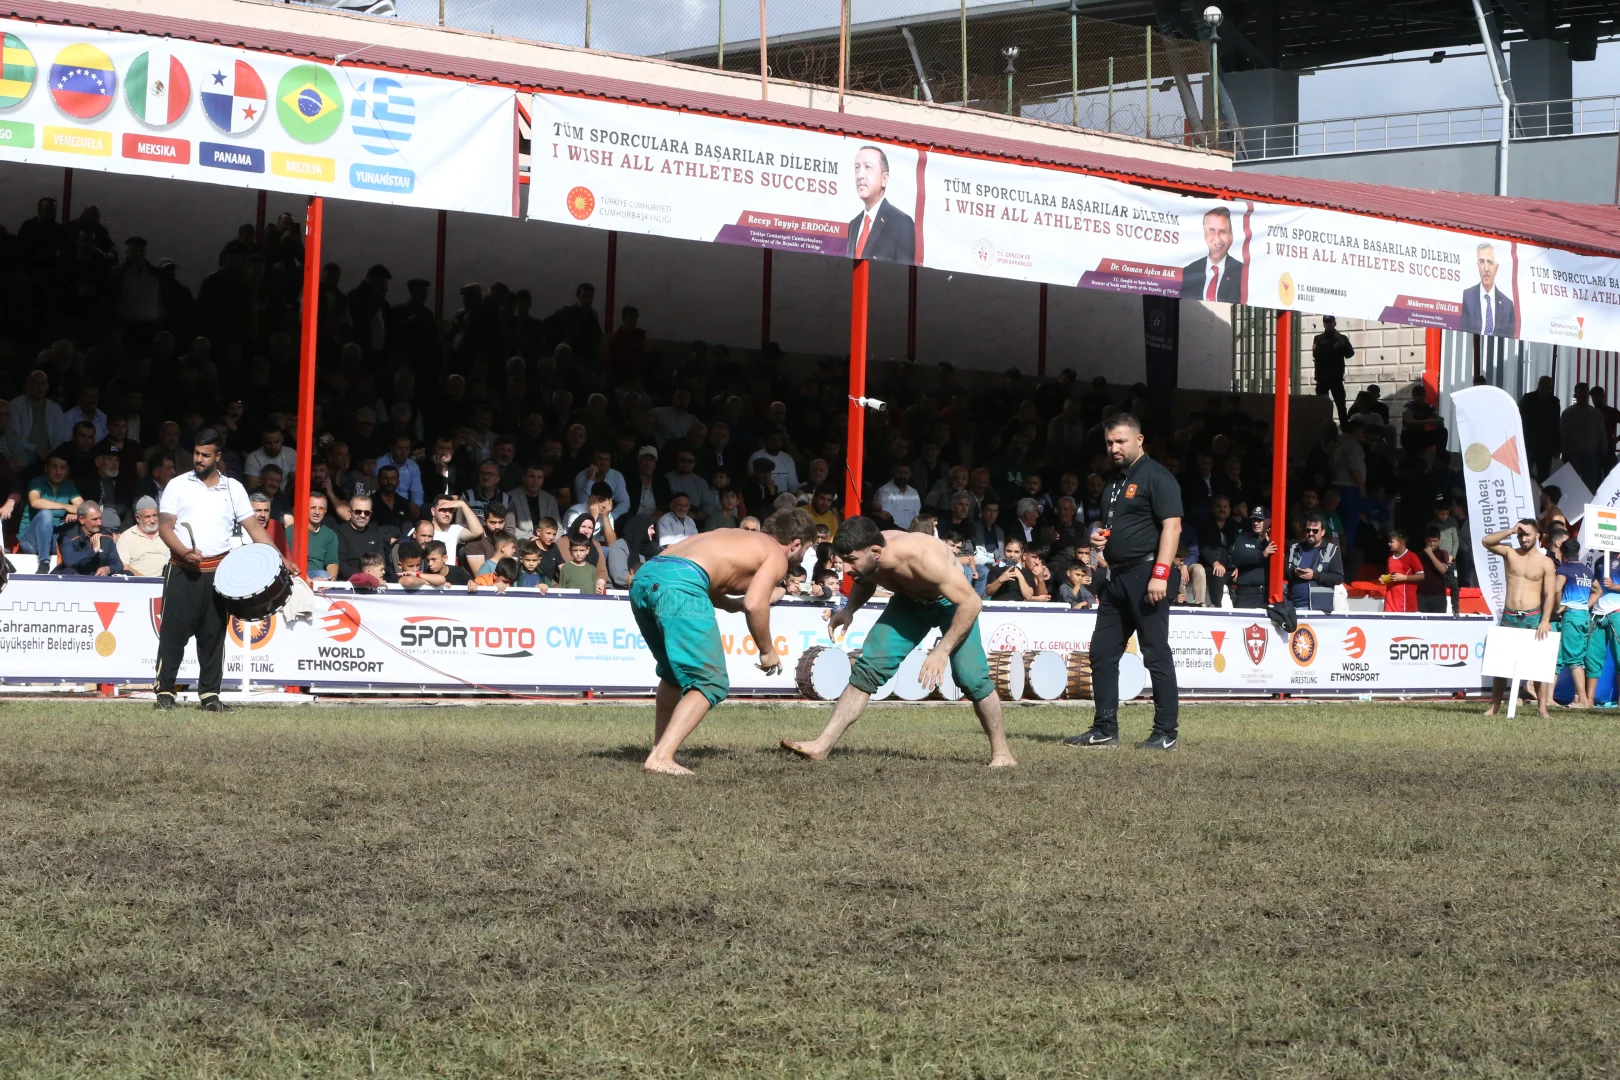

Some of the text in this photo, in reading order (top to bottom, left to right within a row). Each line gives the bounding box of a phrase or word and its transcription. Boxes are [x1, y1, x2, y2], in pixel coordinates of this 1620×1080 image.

[53, 133, 103, 150] VENEZUELA
[553, 122, 838, 175] TÜM SPORCULARA BAŞARILAR DİLERİM
[137, 142, 176, 158] MEKSIKA
[213, 150, 252, 166] PANAMA
[552, 143, 838, 196] I WISH ALL ATHLETES SUCCESS
[356, 169, 410, 189] YUNANİSTAN
[944, 177, 1180, 226] TÜM SPORCULARA BAŞARILAR DİLERİM
[747, 214, 840, 234] Recep Tayyip ERDOĞAN
[945, 198, 1180, 245] I WISH ALL ATHLETES SUCCESS
[1267, 224, 1461, 265] TÜM SPORCULARA BAŞARILAR DİLERİM
[1110, 262, 1120, 271] Dr.
[1121, 264, 1142, 274] Osman
[1162, 269, 1176, 278] BAK
[1266, 242, 1460, 282] I WISH ALL ATHLETES SUCCESS
[1530, 265, 1550, 279] TÜM
[1553, 269, 1606, 288] SPORCULARA
[1532, 282, 1536, 294] I
[1540, 282, 1568, 298] WISH
[1572, 287, 1589, 301] ALL
[0, 637, 94, 653] üyükşehir Belediyesi
[546, 626, 584, 648] CW
[318, 646, 365, 659] WORLD
[1034, 641, 1046, 650] T.C.
[1048, 641, 1077, 652] GENÇLİK
[1171, 647, 1213, 659] amanmaraş
[227, 662, 275, 673] WRTLING
[298, 659, 384, 672] ETHNOSPORT
[1185, 658, 1213, 670] Belediyesi
[1342, 663, 1370, 671] WORLD
[1290, 676, 1318, 684] WRESTLING
[1330, 673, 1380, 682] ETHNOSPORT
